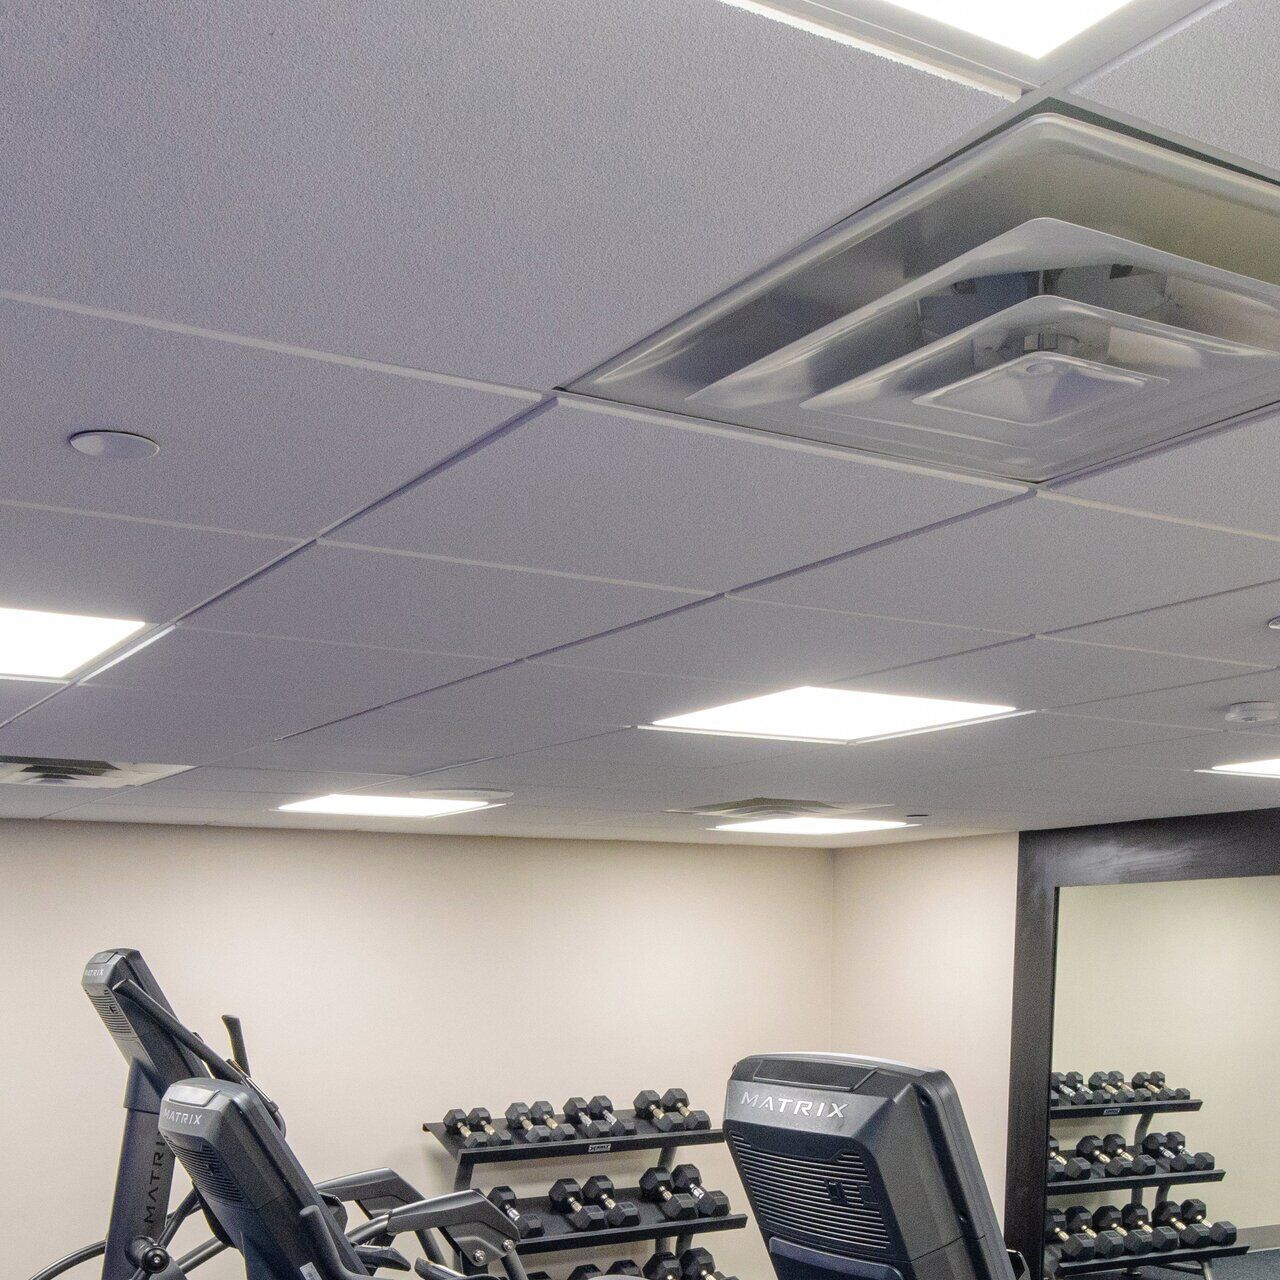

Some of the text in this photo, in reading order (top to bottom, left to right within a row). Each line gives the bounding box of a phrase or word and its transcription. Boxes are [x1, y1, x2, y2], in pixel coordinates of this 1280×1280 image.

[163, 1108, 202, 1125] MATRIX
[740, 1091, 849, 1118] MATRIX
[143, 1131, 166, 1224] MATRI
